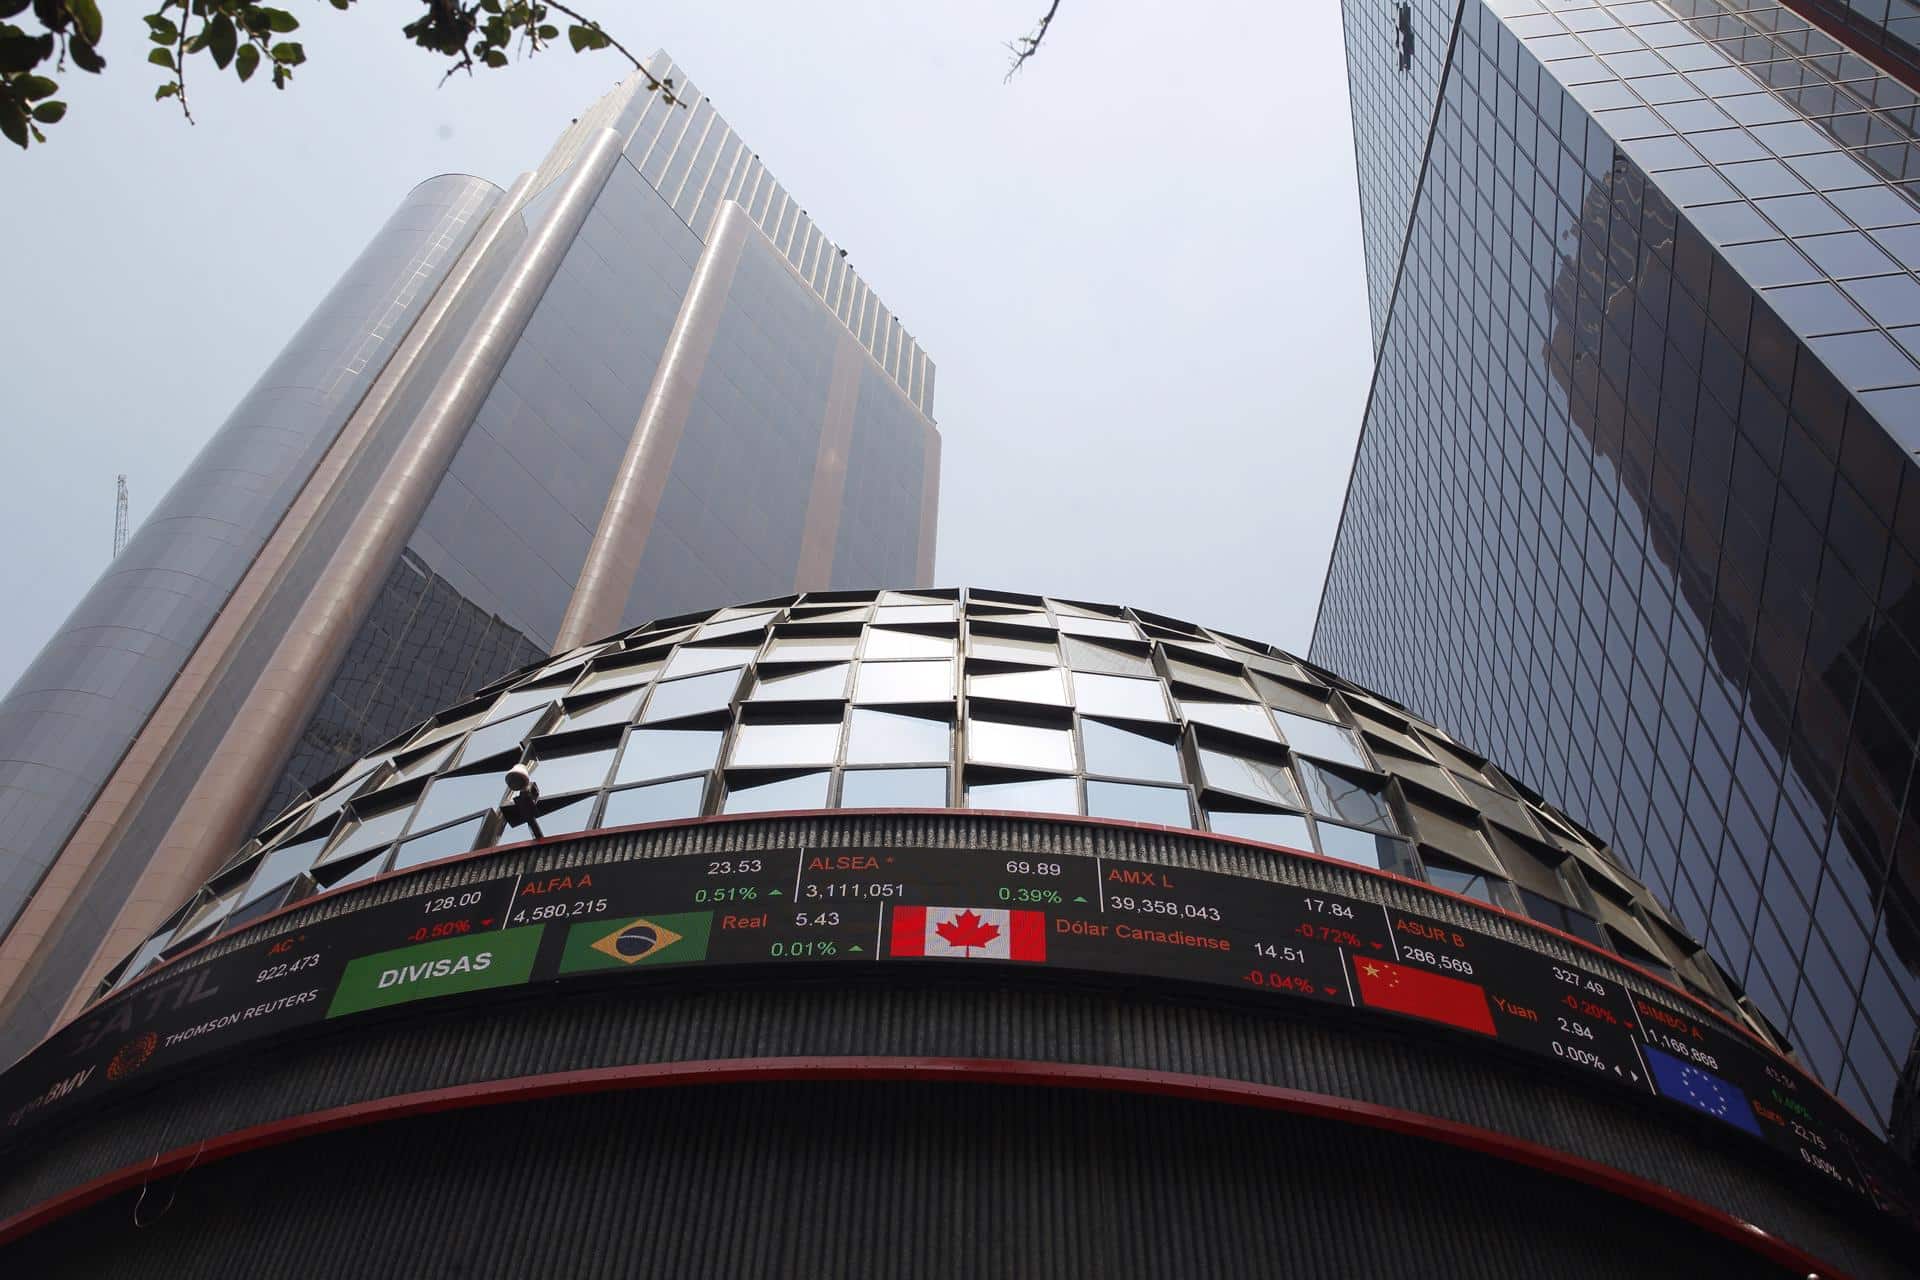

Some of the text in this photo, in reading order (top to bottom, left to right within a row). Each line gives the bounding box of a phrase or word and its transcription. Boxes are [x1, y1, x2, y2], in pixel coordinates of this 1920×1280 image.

[708, 859, 762, 875] 23.53
[808, 857, 879, 870] ALSEA
[1005, 861, 1061, 876] 69.89
[521, 873, 593, 896] ALFA A
[1108, 869, 1175, 888] AMX L
[695, 887, 758, 903] 0.51%
[805, 883, 904, 899] 3,111,051
[998, 887, 1062, 904] 0.39%
[424, 891, 482, 914] 128.00
[513, 899, 608, 924] 4,580,215
[1110, 896, 1221, 921] 39,358,043
[1303, 898, 1355, 919] 17.84
[721, 913, 768, 929] Real
[795, 911, 840, 926] 5.43
[407, 920, 471, 942] -0.50%
[1056, 918, 1231, 951] Dólar Canadiense
[1295, 923, 1361, 948] -0.72%
[1395, 920, 1448, 942] ASUR
[770, 941, 837, 957] 0.01%
[1254, 942, 1305, 963] 14.51
[1402, 945, 1473, 975] 286,569
[256, 953, 320, 983] 922,473
[377, 952, 493, 990] DIVISAS
[1241, 970, 1314, 994] -0.04%
[165, 989, 319, 1048] THOMSON REUTERS
[1494, 995, 1538, 1022] Yuan
[1557, 1017, 1594, 1040] 2.94
[1552, 1041, 1605, 1070] 0.00%
